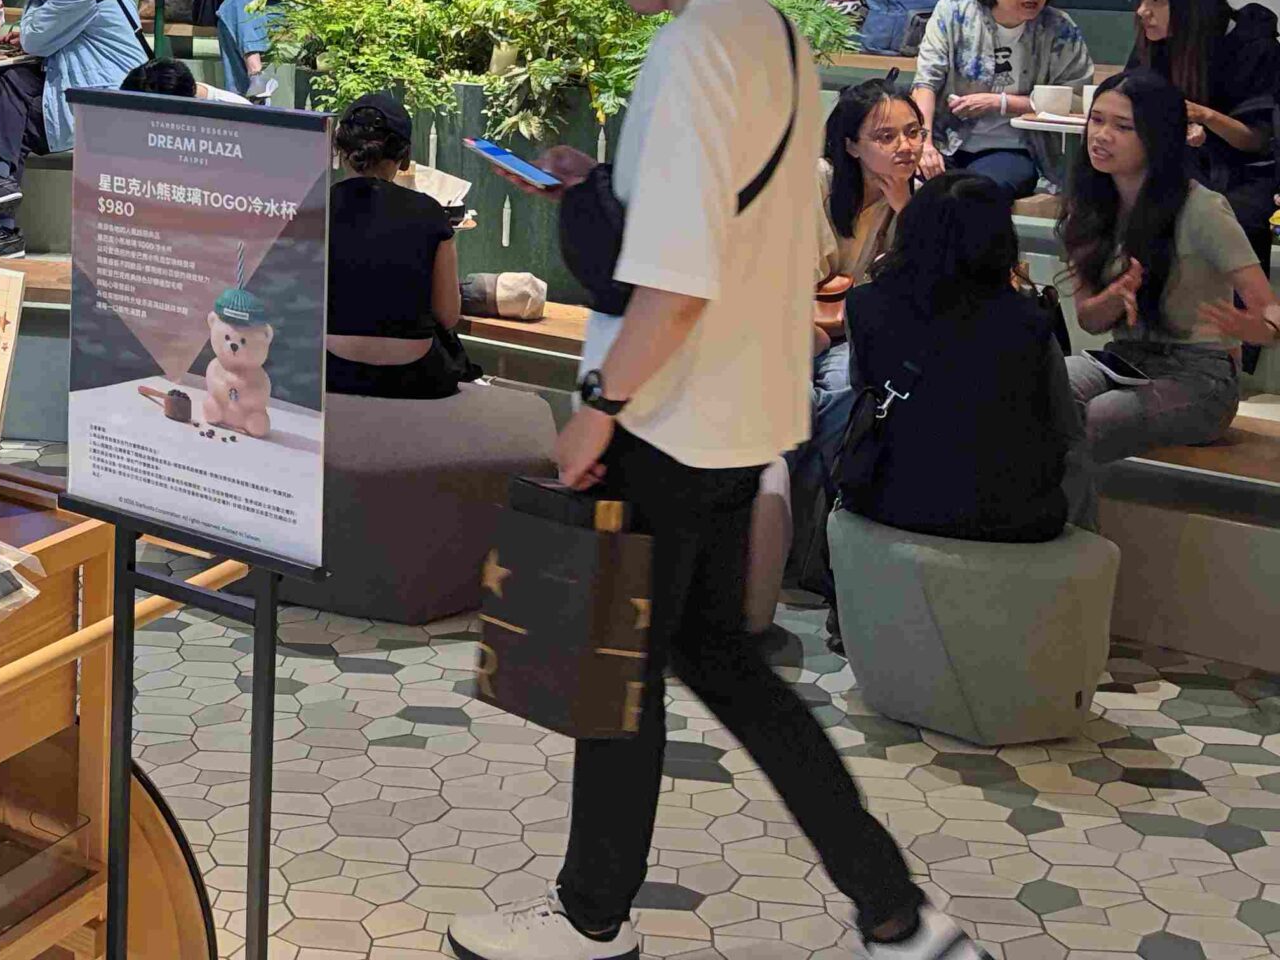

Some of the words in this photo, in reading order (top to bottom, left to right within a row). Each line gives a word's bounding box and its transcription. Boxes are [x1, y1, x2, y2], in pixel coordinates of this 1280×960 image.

[150, 121, 197, 133] STARBUCKS
[200, 126, 240, 138] RESERVE
[148, 133, 196, 153] DREAM
[199, 139, 243, 159] PLAZA
[178, 154, 209, 166] TAIPEI
[98, 173, 298, 220] 星巴克小熊玻璃TOGO冷水杯
[98, 196, 135, 217] $980
